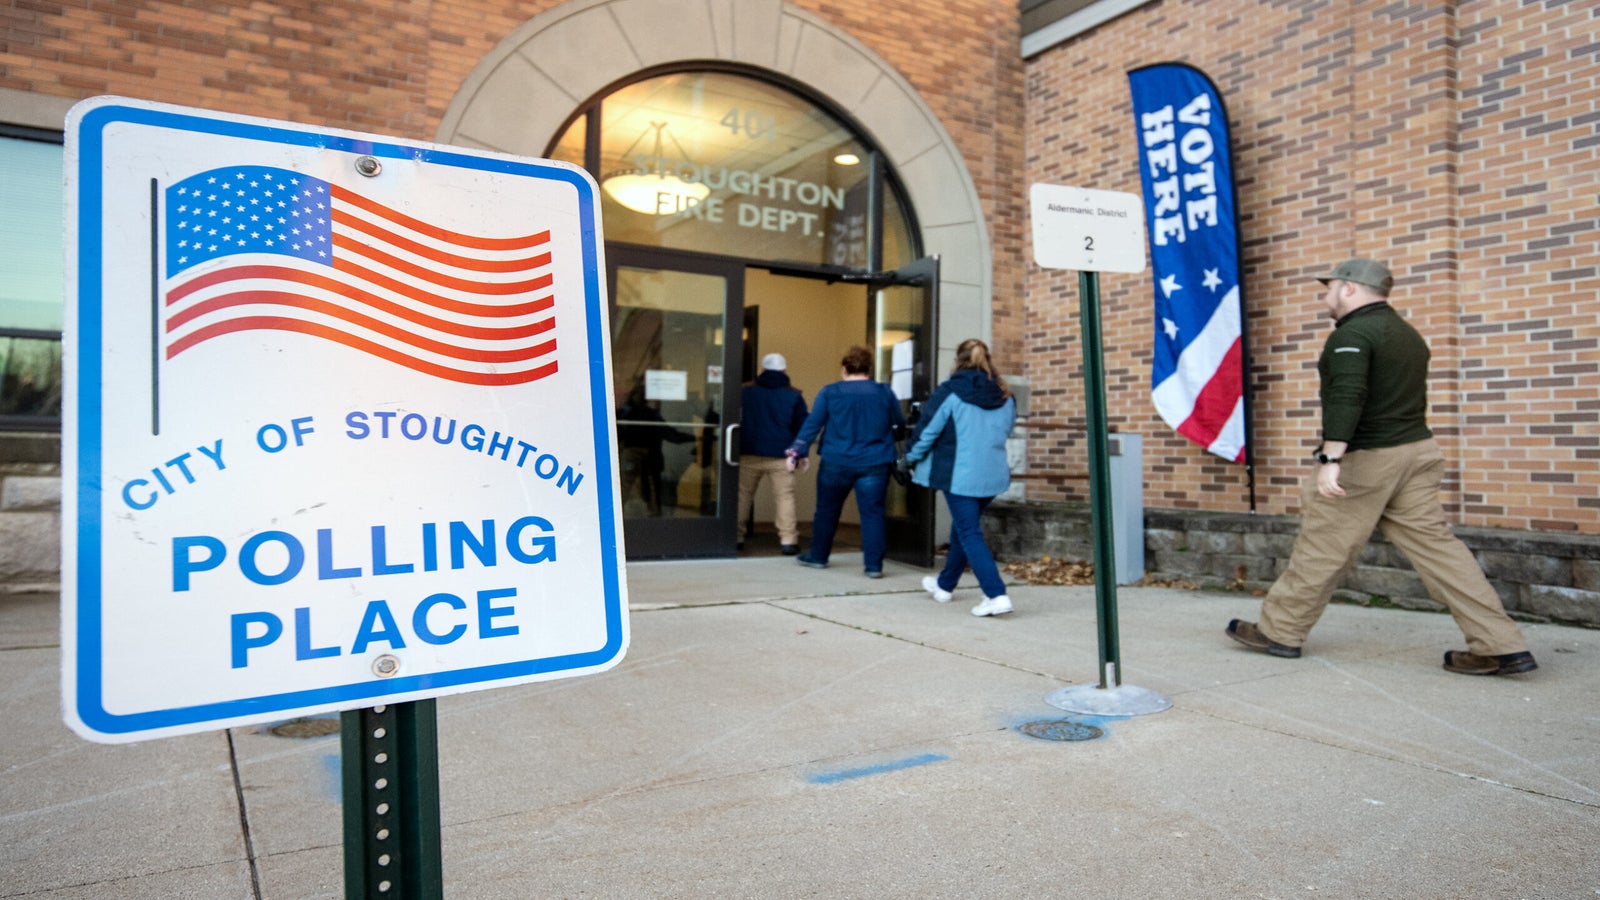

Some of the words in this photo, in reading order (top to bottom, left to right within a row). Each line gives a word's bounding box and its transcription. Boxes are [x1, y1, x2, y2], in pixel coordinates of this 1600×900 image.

[720, 107, 776, 143] 401
[632, 154, 845, 210] STOUGHTON
[1141, 105, 1186, 246] HERE
[1177, 92, 1218, 231] VOTE
[656, 191, 724, 223] FIRE
[738, 203, 825, 238] DEPT.
[1048, 203, 1094, 216] Aldermanic
[1097, 208, 1128, 218] District
[1084, 236, 1094, 251] 2
[122, 439, 226, 511] CITY
[256, 416, 314, 454] OF
[346, 412, 584, 497] STOUGHTON
[172, 516, 557, 593] POLLING
[230, 587, 520, 669] PLACE
